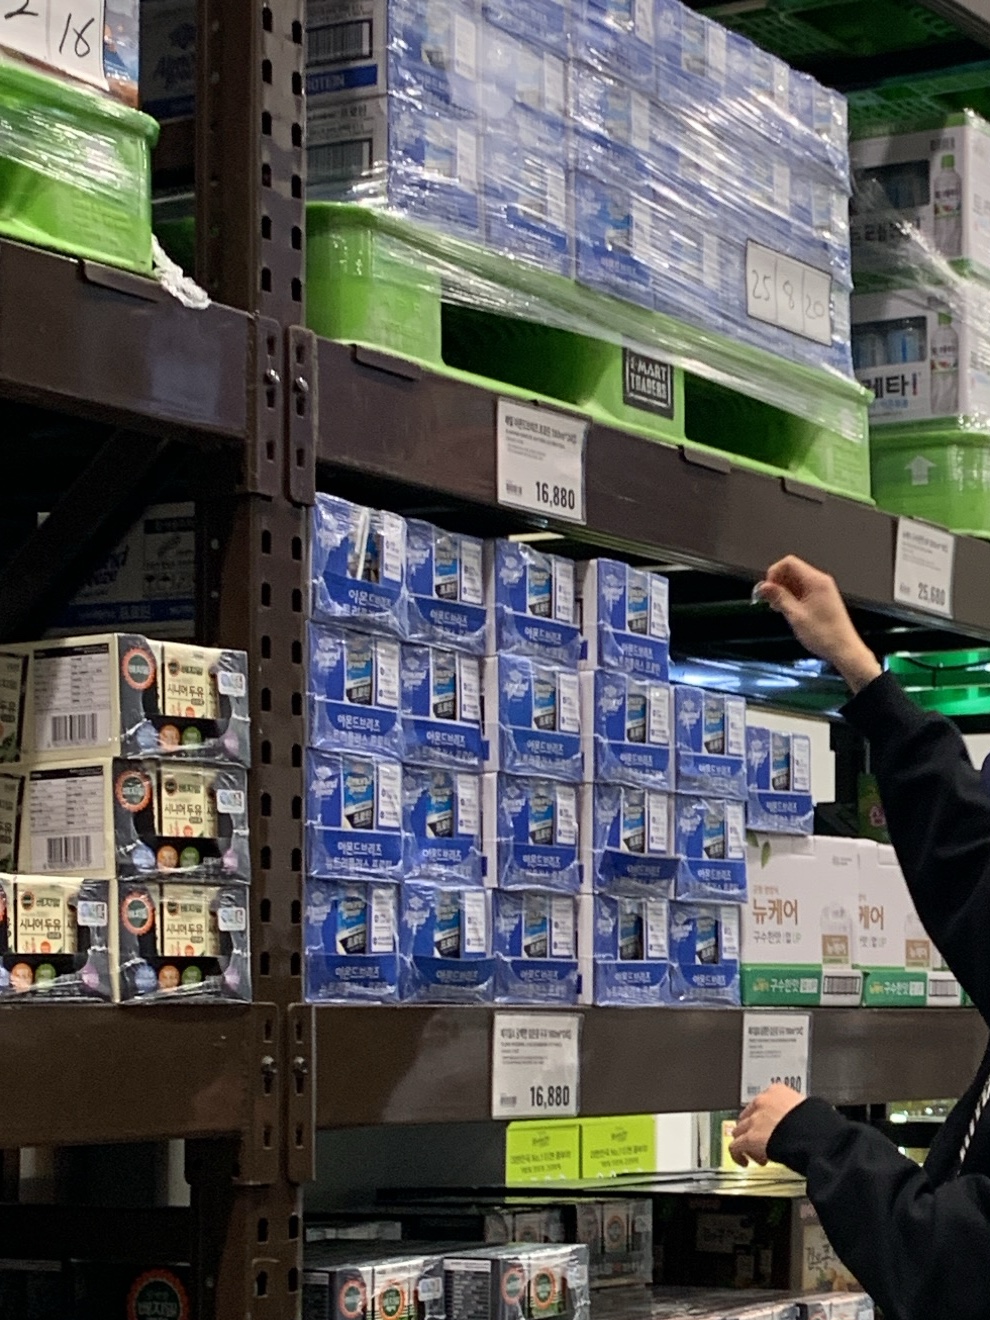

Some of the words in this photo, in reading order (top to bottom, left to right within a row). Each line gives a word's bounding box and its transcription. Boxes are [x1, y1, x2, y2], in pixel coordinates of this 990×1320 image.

[58, 13, 95, 58] 18
[751, 269, 772, 302] 25
[804, 294, 825, 319] 20
[535, 480, 576, 510] 16,880
[337, 713, 381, 732] 아몬드브리즈
[337, 841, 383, 857] 아몬드브리즈
[752, 898, 799, 926] 뉴케어
[752, 931, 782, 945] 구수한맛
[770, 977, 801, 993] 구수한맛
[529, 1084, 570, 1109] 16,880
